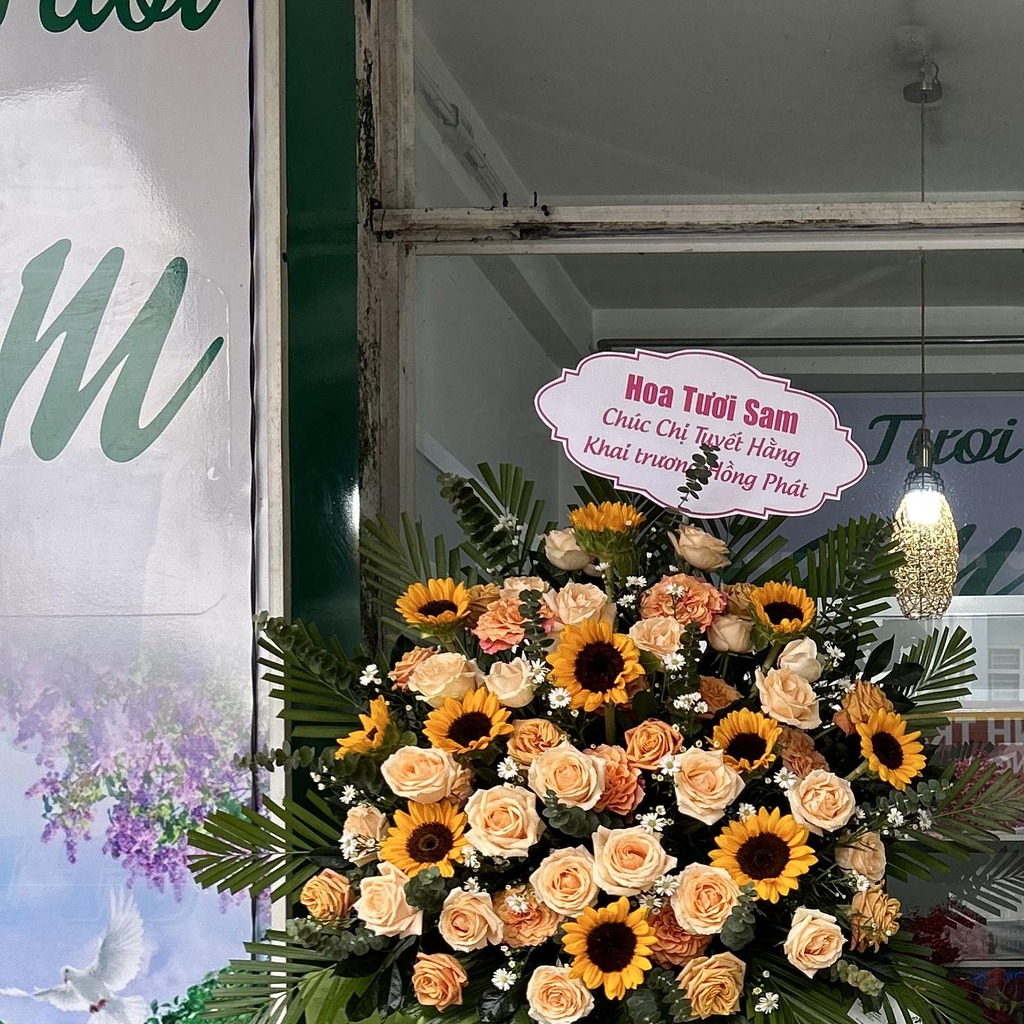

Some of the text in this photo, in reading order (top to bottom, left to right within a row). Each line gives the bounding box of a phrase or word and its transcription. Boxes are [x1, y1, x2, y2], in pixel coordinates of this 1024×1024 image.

[625, 373, 800, 435] Hoa Tươi Sam
[583, 435, 630, 462] Khai
[634, 447, 696, 474] trươn
[762, 472, 809, 499] Phát
[602, 407, 801, 468] Chúc Chị Tuyết Hằng
